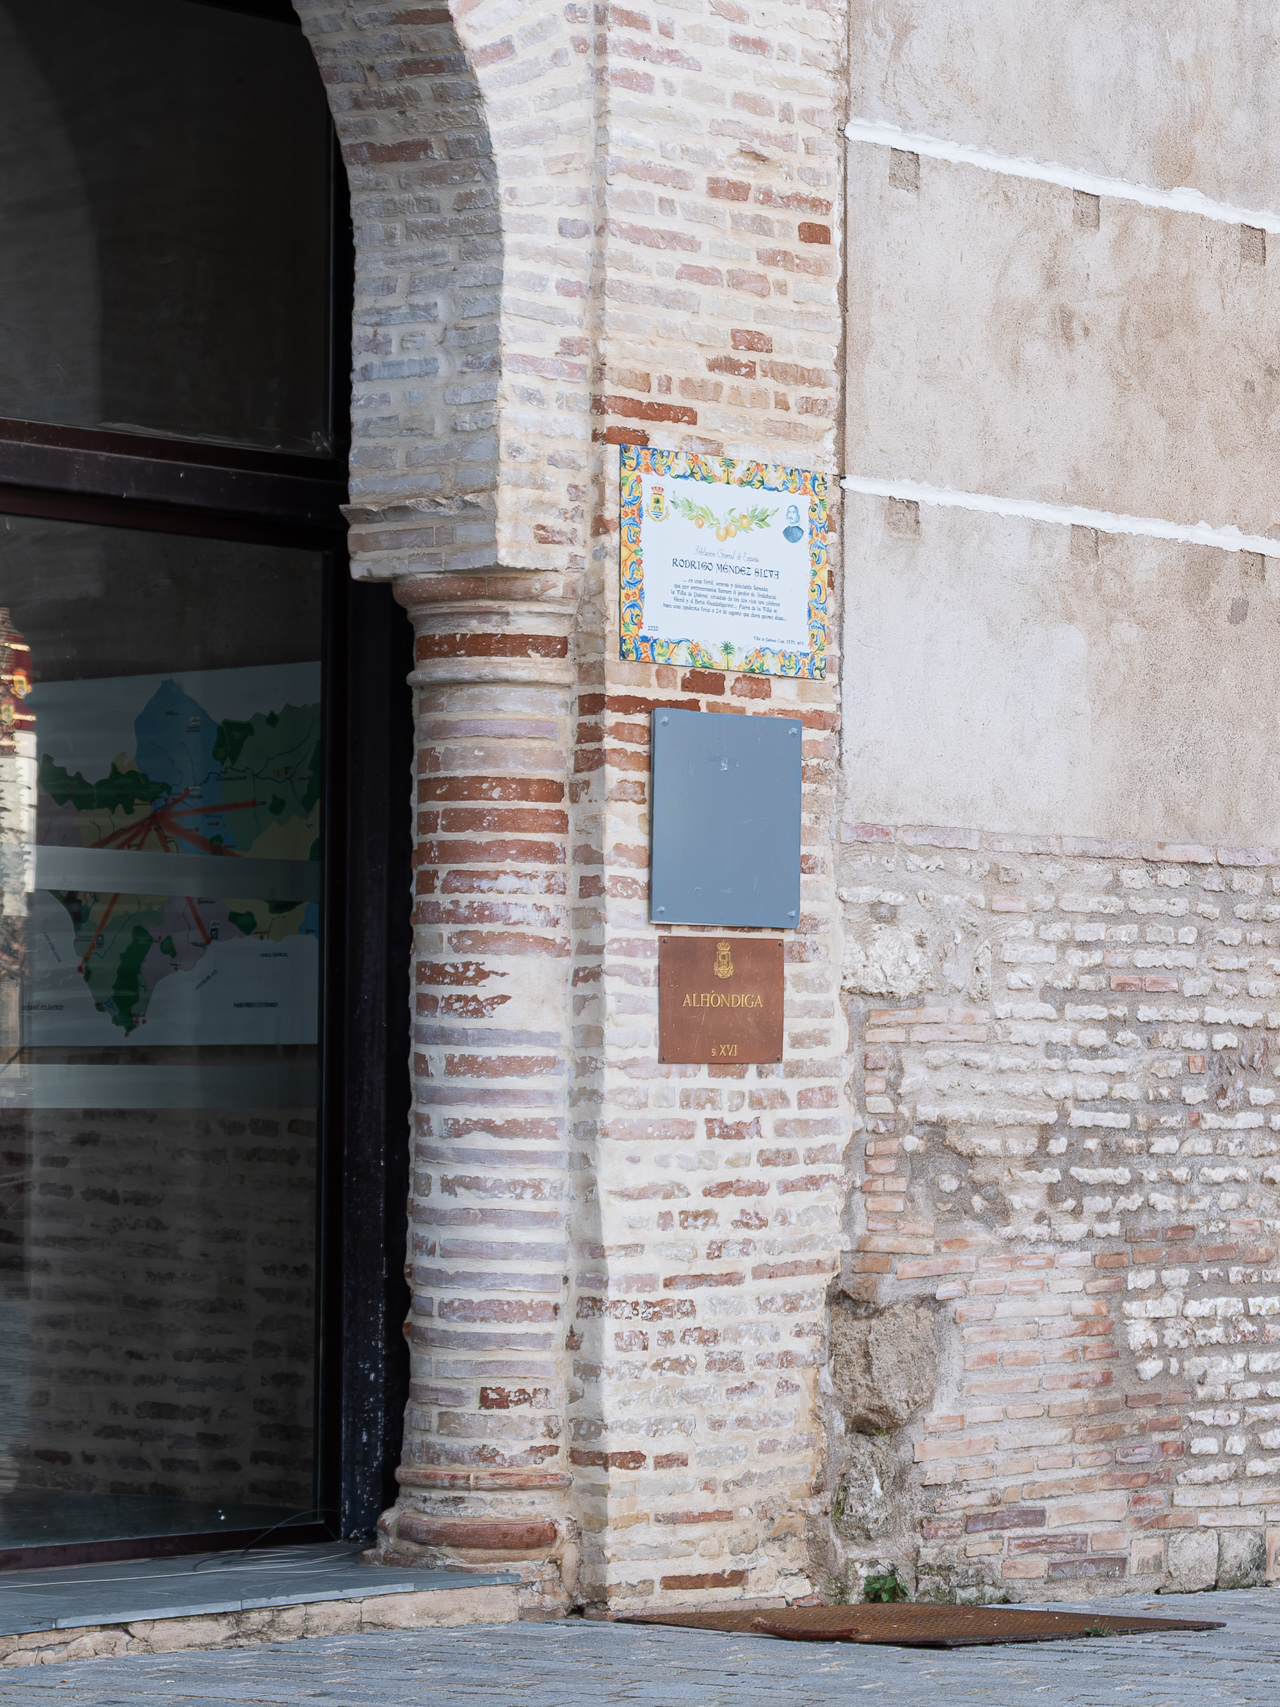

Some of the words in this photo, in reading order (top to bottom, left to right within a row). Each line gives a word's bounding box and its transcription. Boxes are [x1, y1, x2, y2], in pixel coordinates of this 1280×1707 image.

[672, 558, 714, 572] RODRIGO
[716, 562, 751, 576] MÉNDEZ
[754, 568, 780, 580] SILVA
[682, 990, 764, 1008] ALHÓNDIGA
[720, 1044, 738, 1056] XVI
